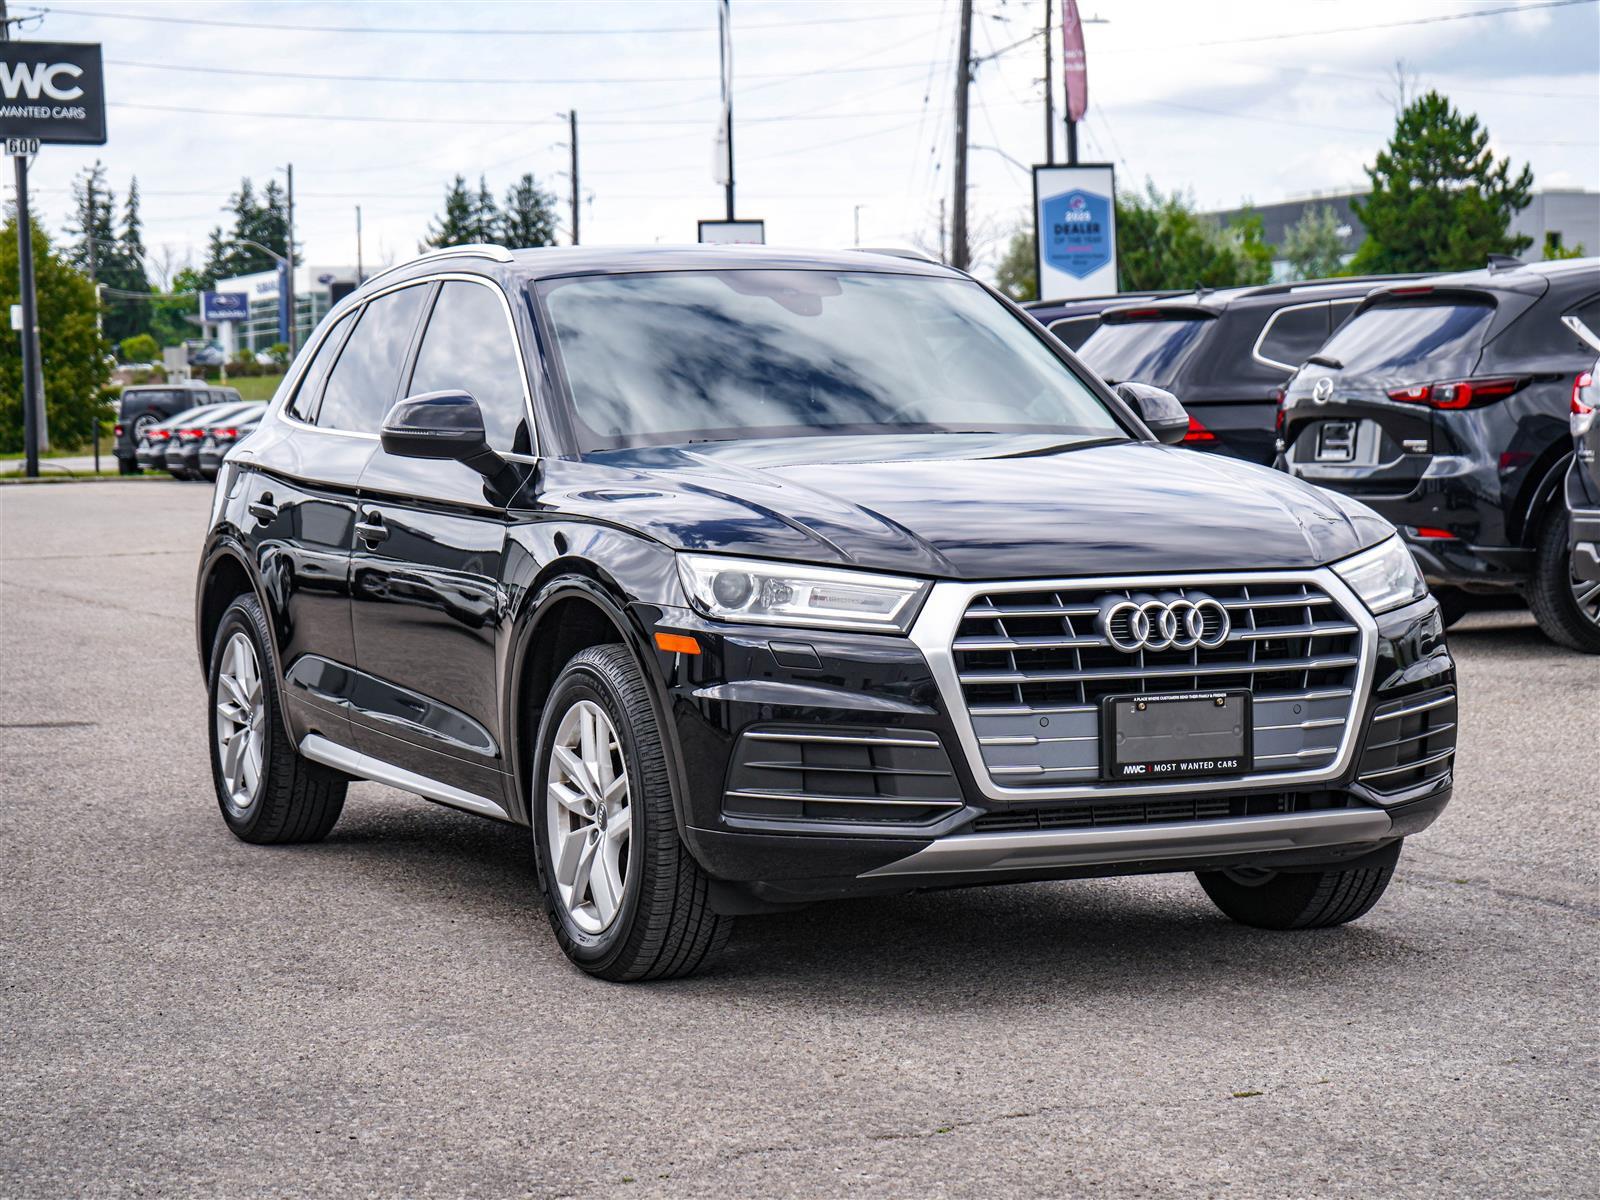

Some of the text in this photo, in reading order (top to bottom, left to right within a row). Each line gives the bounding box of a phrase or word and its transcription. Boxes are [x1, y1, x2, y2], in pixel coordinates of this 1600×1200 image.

[52, 106, 86, 119] CARS
[9, 139, 38, 154] 600
[1054, 223, 1100, 235] DEALER
[1154, 763, 1176, 772] MOST
[1180, 761, 1214, 770] WANTED
[1217, 760, 1238, 768] CARS
